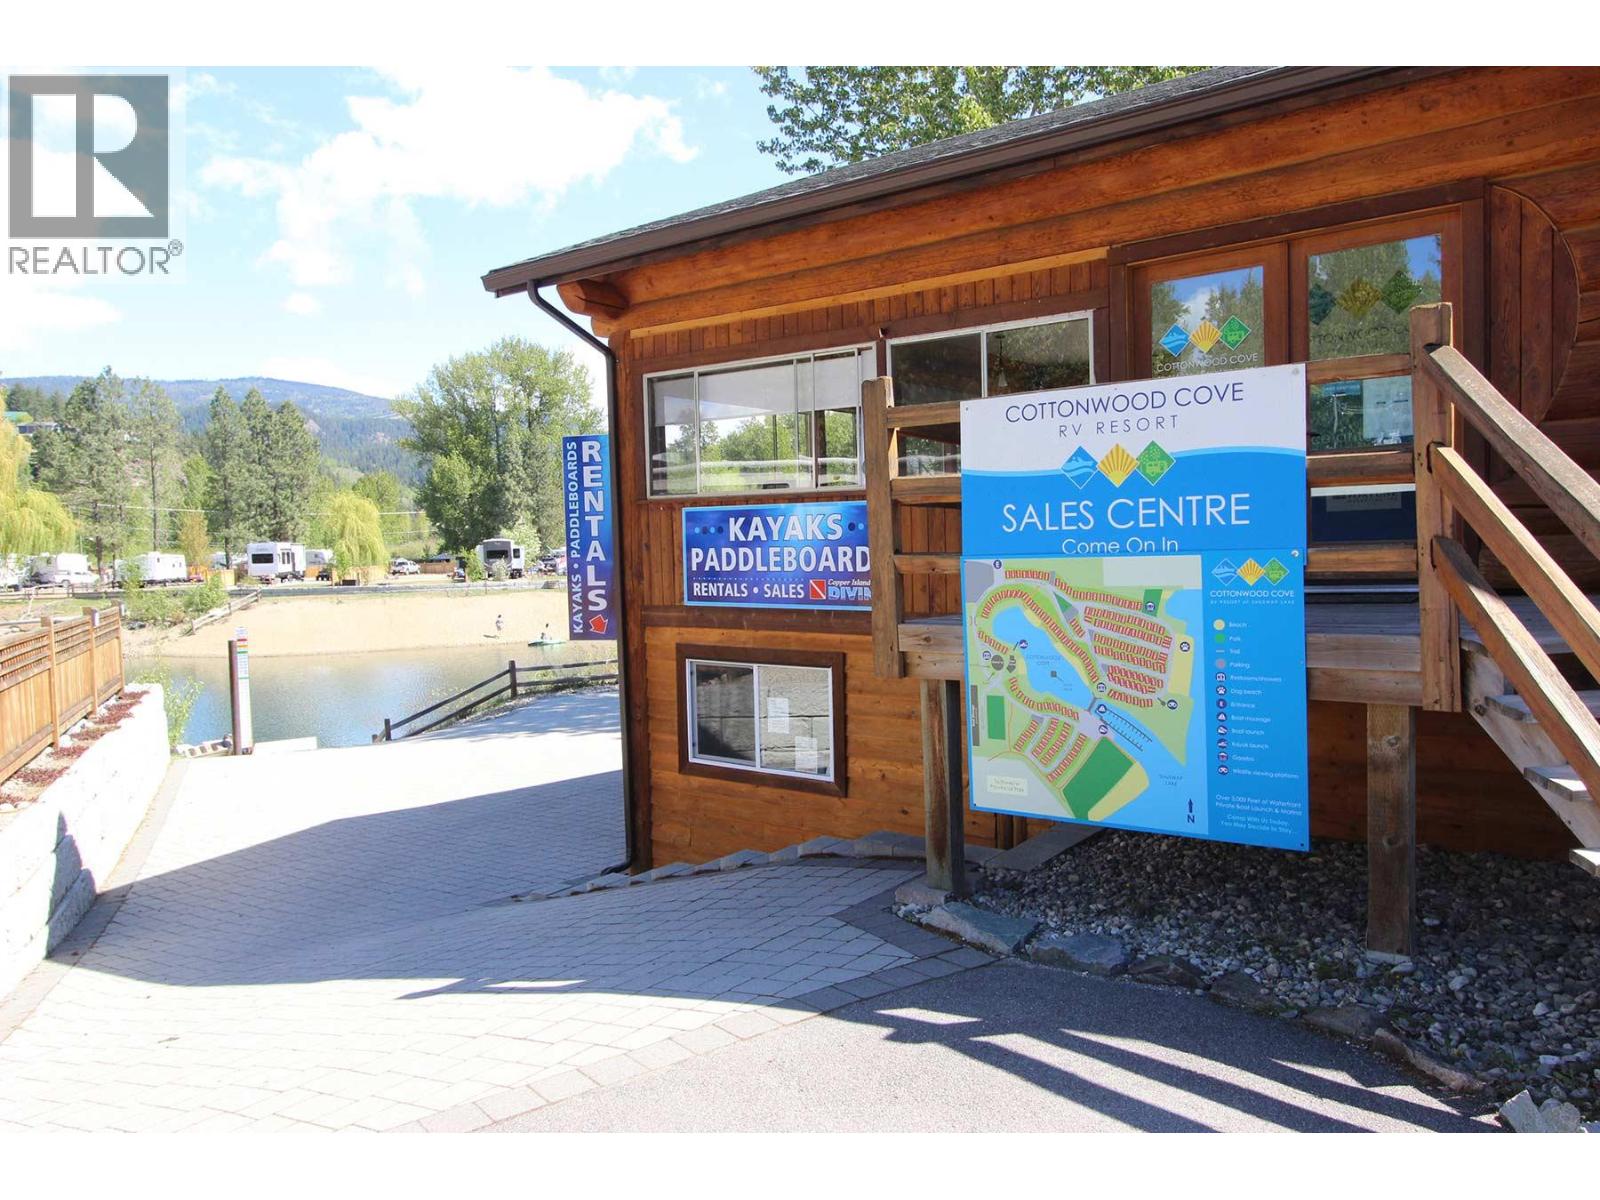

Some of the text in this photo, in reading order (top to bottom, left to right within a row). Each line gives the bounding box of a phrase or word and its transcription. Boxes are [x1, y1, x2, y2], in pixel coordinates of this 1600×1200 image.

[1157, 356, 1227, 372] COTTONWOOD
[1229, 352, 1259, 364] COVE
[1005, 382, 1244, 423] COTTONWOOD COVE
[1058, 415, 1179, 438] RV RESORT
[1002, 493, 1250, 533] SALES CENTRE
[581, 440, 608, 611] RENTALS
[728, 512, 844, 542] KAYAKS
[566, 441, 584, 633] KAYAKS PADDLEBOARDS
[1061, 536, 1179, 555] Come On In
[693, 582, 805, 599] RENTALS SALES
[827, 578, 850, 587] Copper
[1209, 590, 1295, 598] COTTONWOOD COVE
[1187, 815, 1195, 824] N
